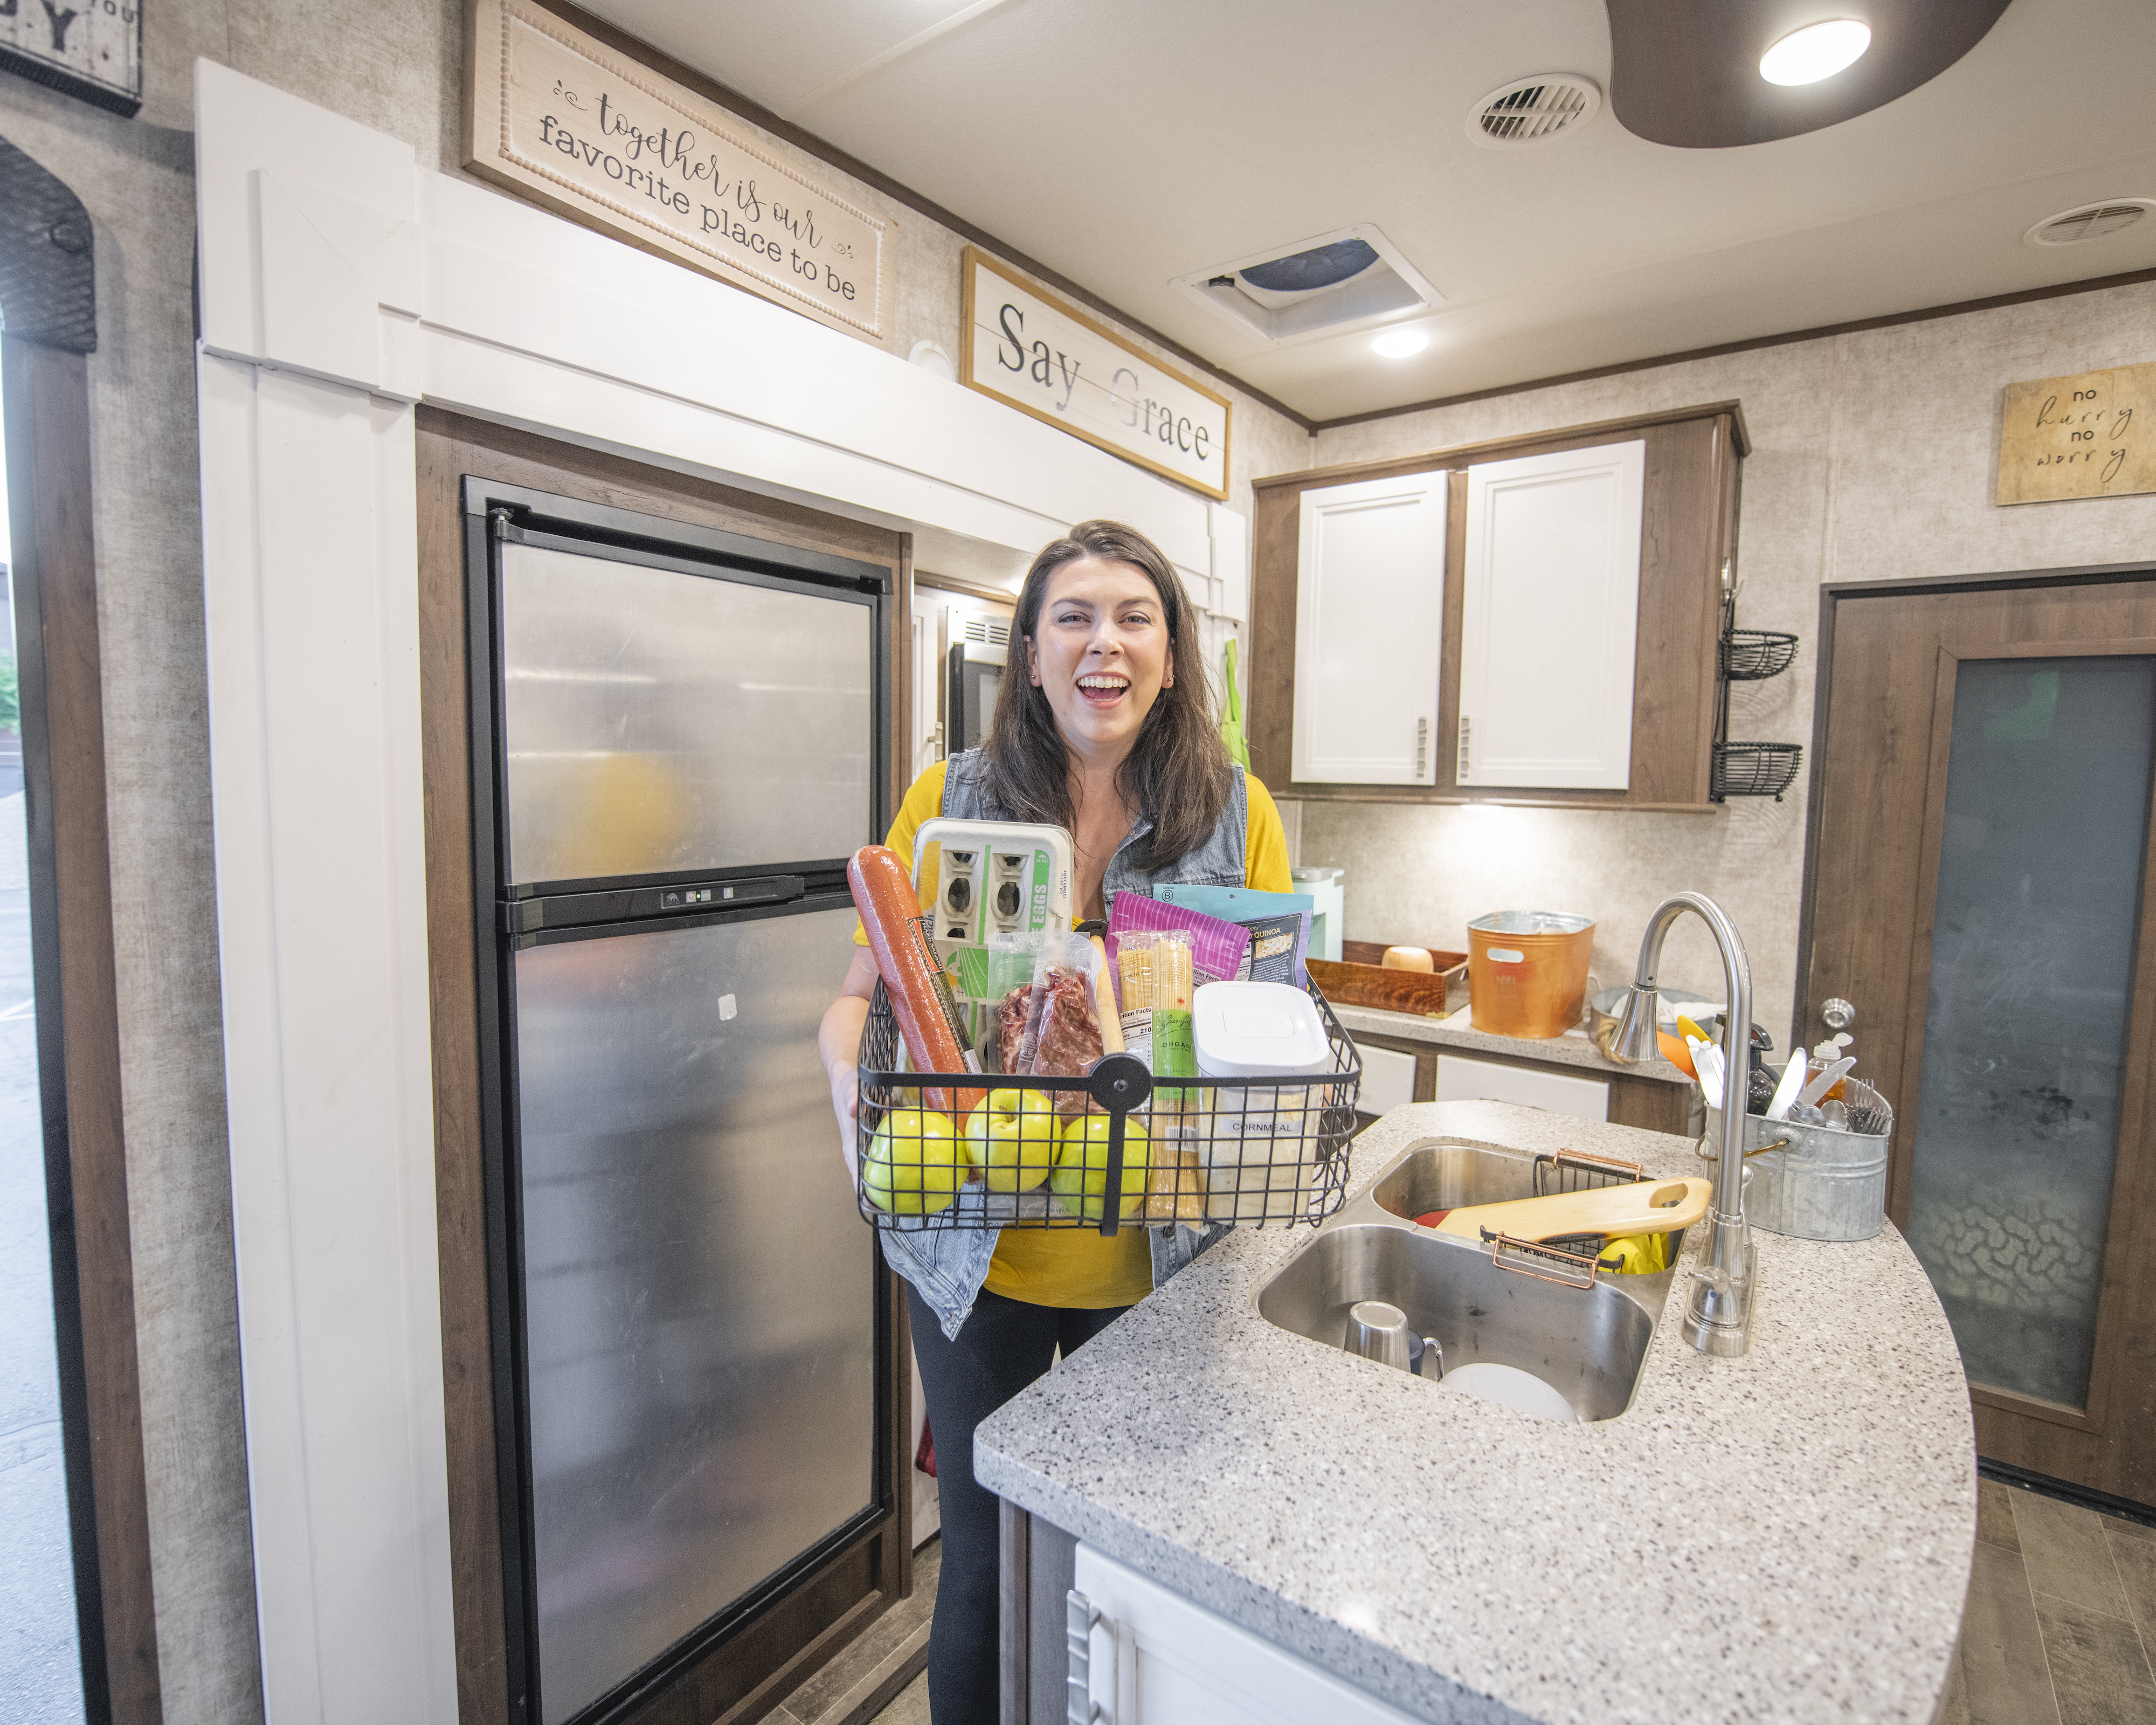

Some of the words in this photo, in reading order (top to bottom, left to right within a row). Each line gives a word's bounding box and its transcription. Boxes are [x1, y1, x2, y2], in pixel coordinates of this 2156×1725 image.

[596, 93, 729, 197] together
[737, 180, 767, 223] is
[773, 201, 823, 249] our
[540, 115, 690, 215] favorite
[701, 203, 782, 263] place
[791, 252, 818, 281] to
[827, 265, 856, 301] be
[998, 303, 1081, 411] Say
[1111, 368, 1208, 460] Grace
[2074, 390, 2096, 402] no
[2036, 396, 2132, 440] hurry
[2071, 430, 2094, 441] no
[2037, 448, 2125, 483] worry
[1032, 884, 1047, 923] EGGS
[1254, 927, 1281, 939] QUINOA
[922, 922, 932, 942] HARD
[930, 943, 943, 969] SALAMI
[1206, 974, 1220, 983] Facts
[1120, 1011, 1135, 1019] trition
[1159, 1015, 1191, 1032] Garofal
[1163, 1041, 1191, 1050] ORGANI
[1233, 1122, 1292, 1133] CORNMEAL
